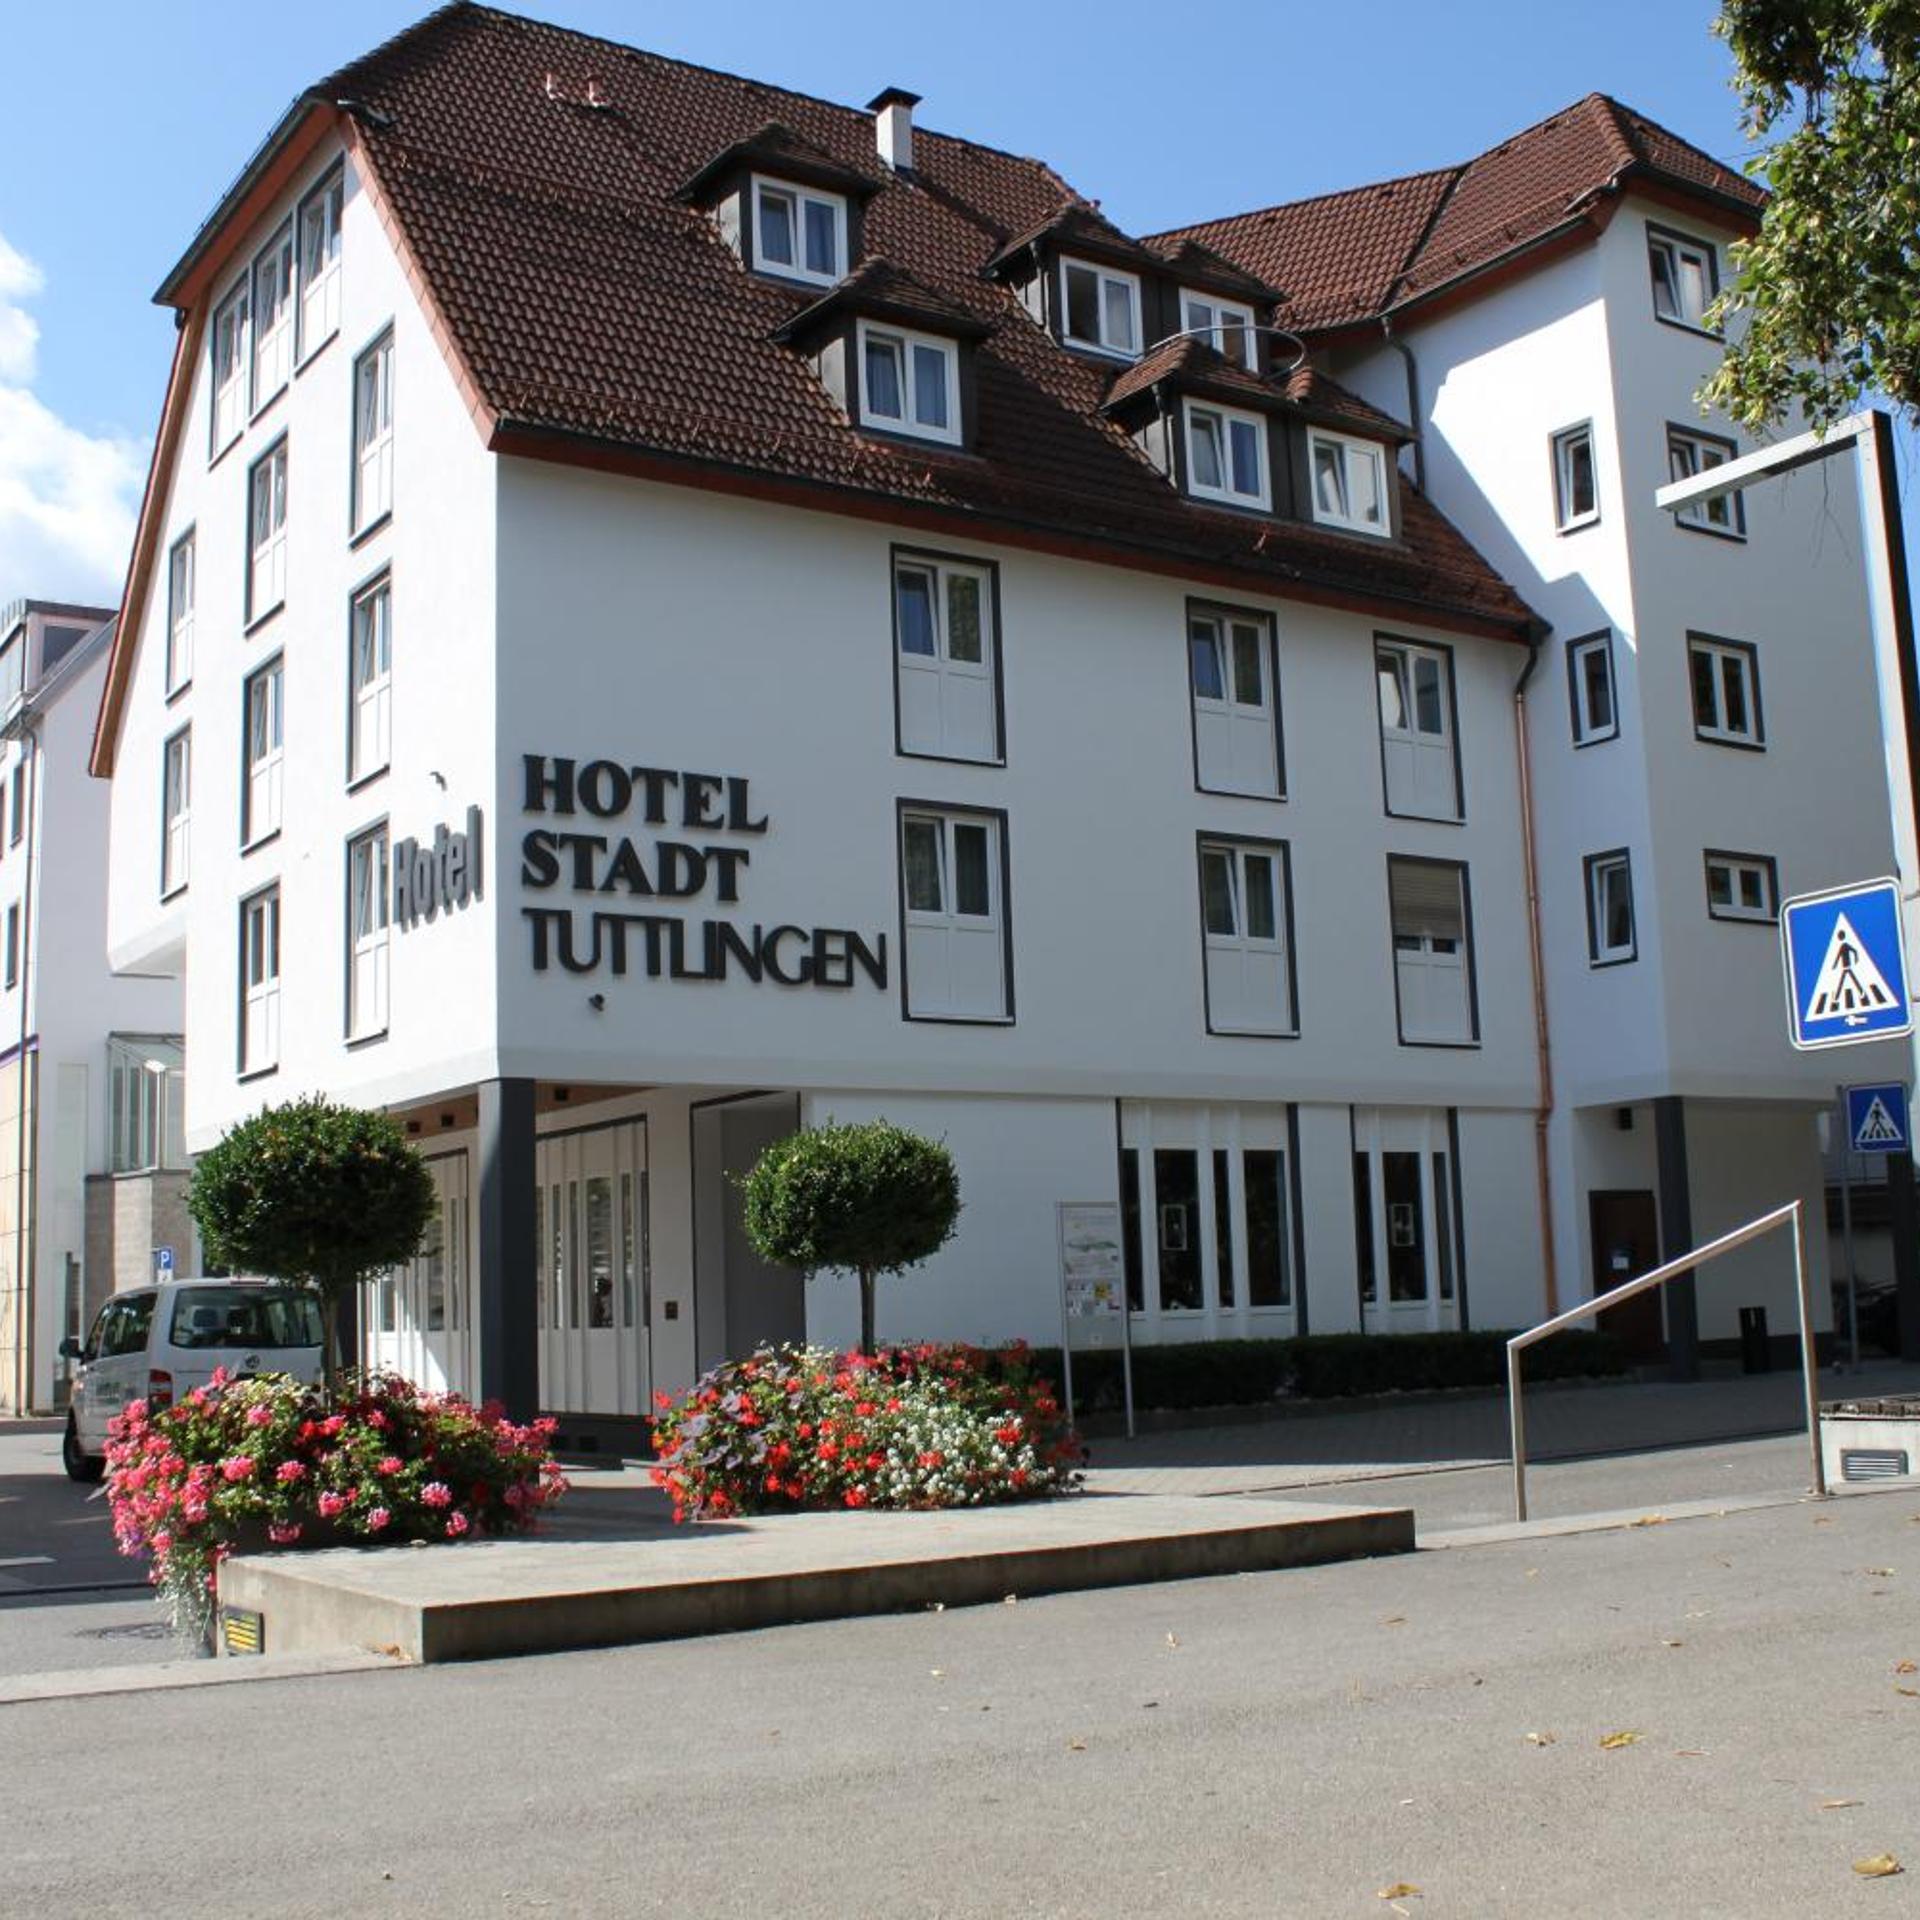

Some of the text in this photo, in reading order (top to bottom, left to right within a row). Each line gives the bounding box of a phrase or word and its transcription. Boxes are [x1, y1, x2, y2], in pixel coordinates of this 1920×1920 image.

[523, 754, 768, 833] HOTEL
[393, 804, 484, 932] Hotel
[522, 829, 750, 902] STADT
[521, 907, 888, 990] TUTTLINGEN
[161, 1251, 170, 1270] P
